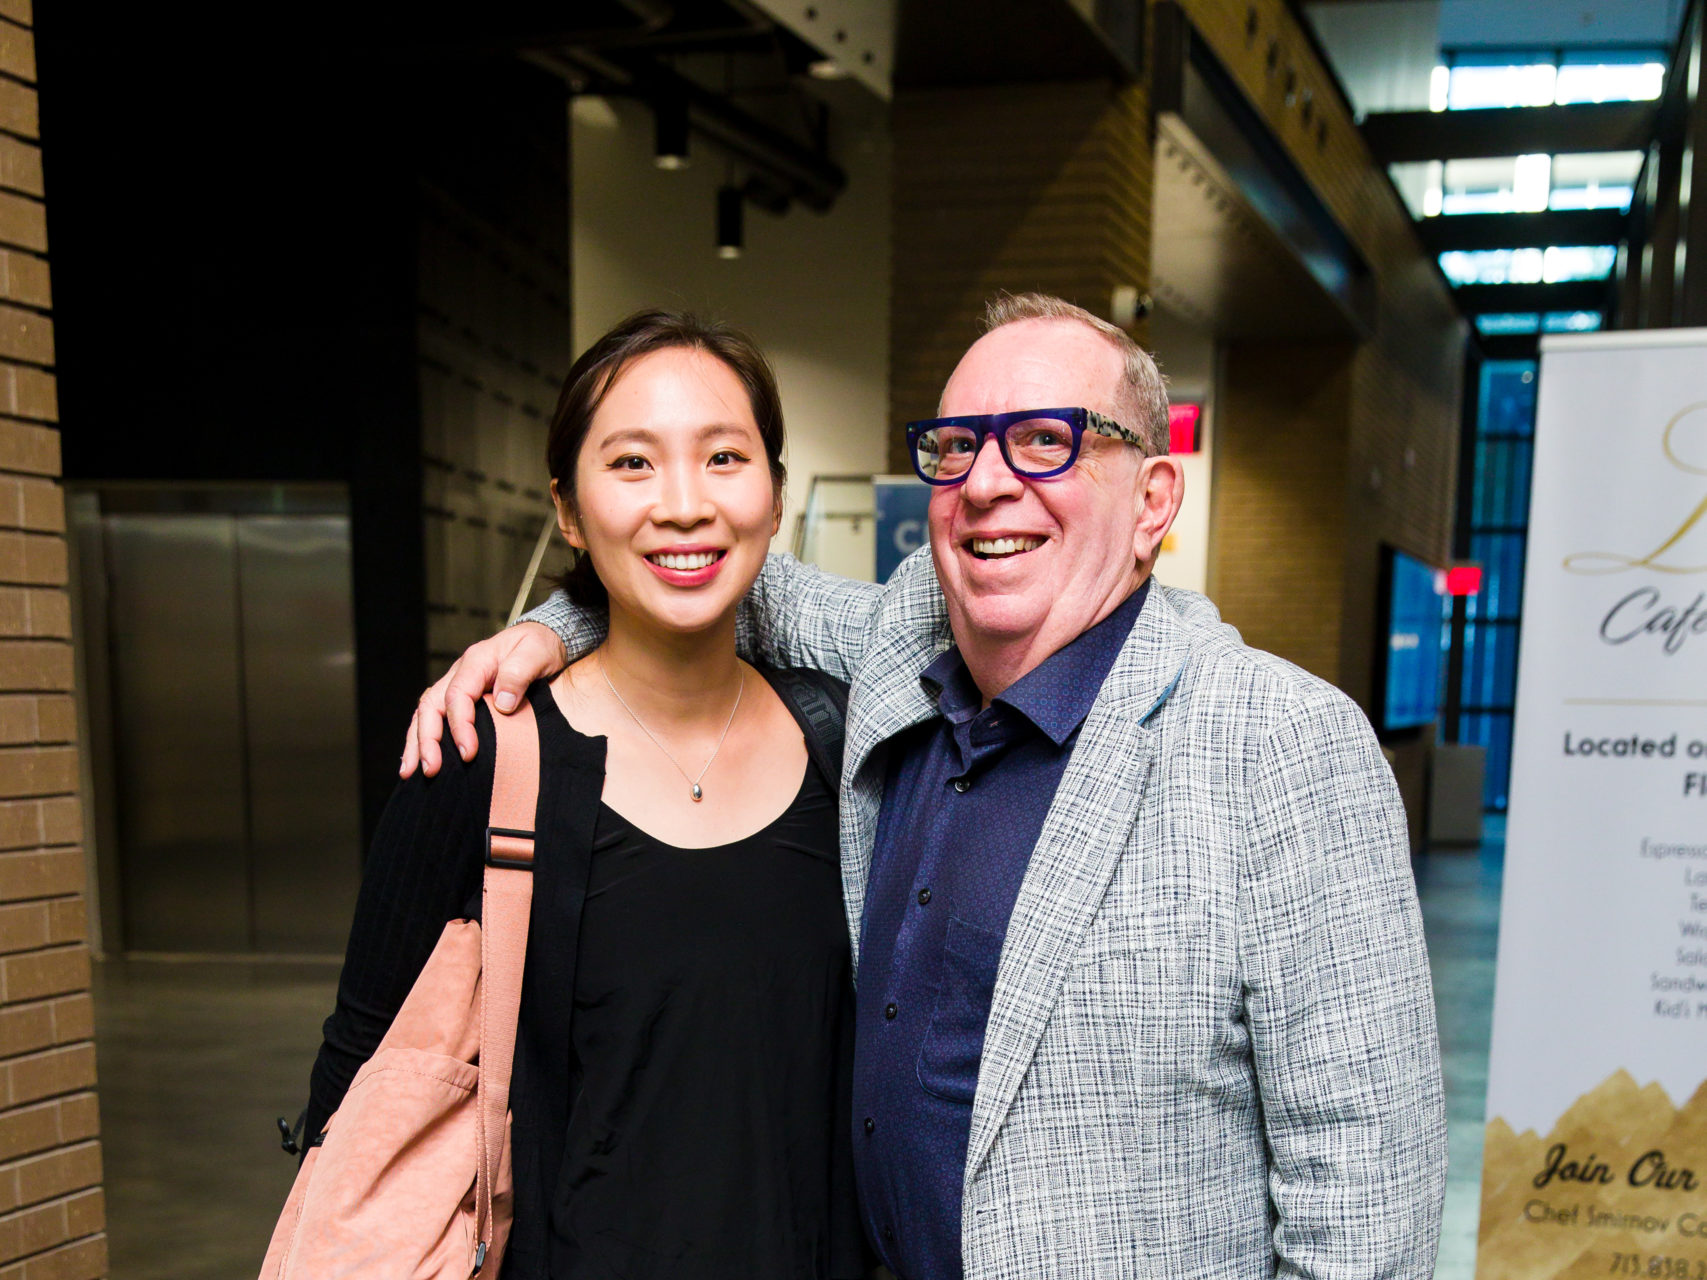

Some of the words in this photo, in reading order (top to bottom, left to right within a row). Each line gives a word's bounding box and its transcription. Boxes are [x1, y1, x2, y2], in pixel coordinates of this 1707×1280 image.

[1563, 731, 1677, 757] Located
[1686, 739, 1707, 758] o
[1533, 1143, 1615, 1189] Join
[1627, 1149, 1698, 1192] Our
[1523, 1199, 1580, 1226] Chef
